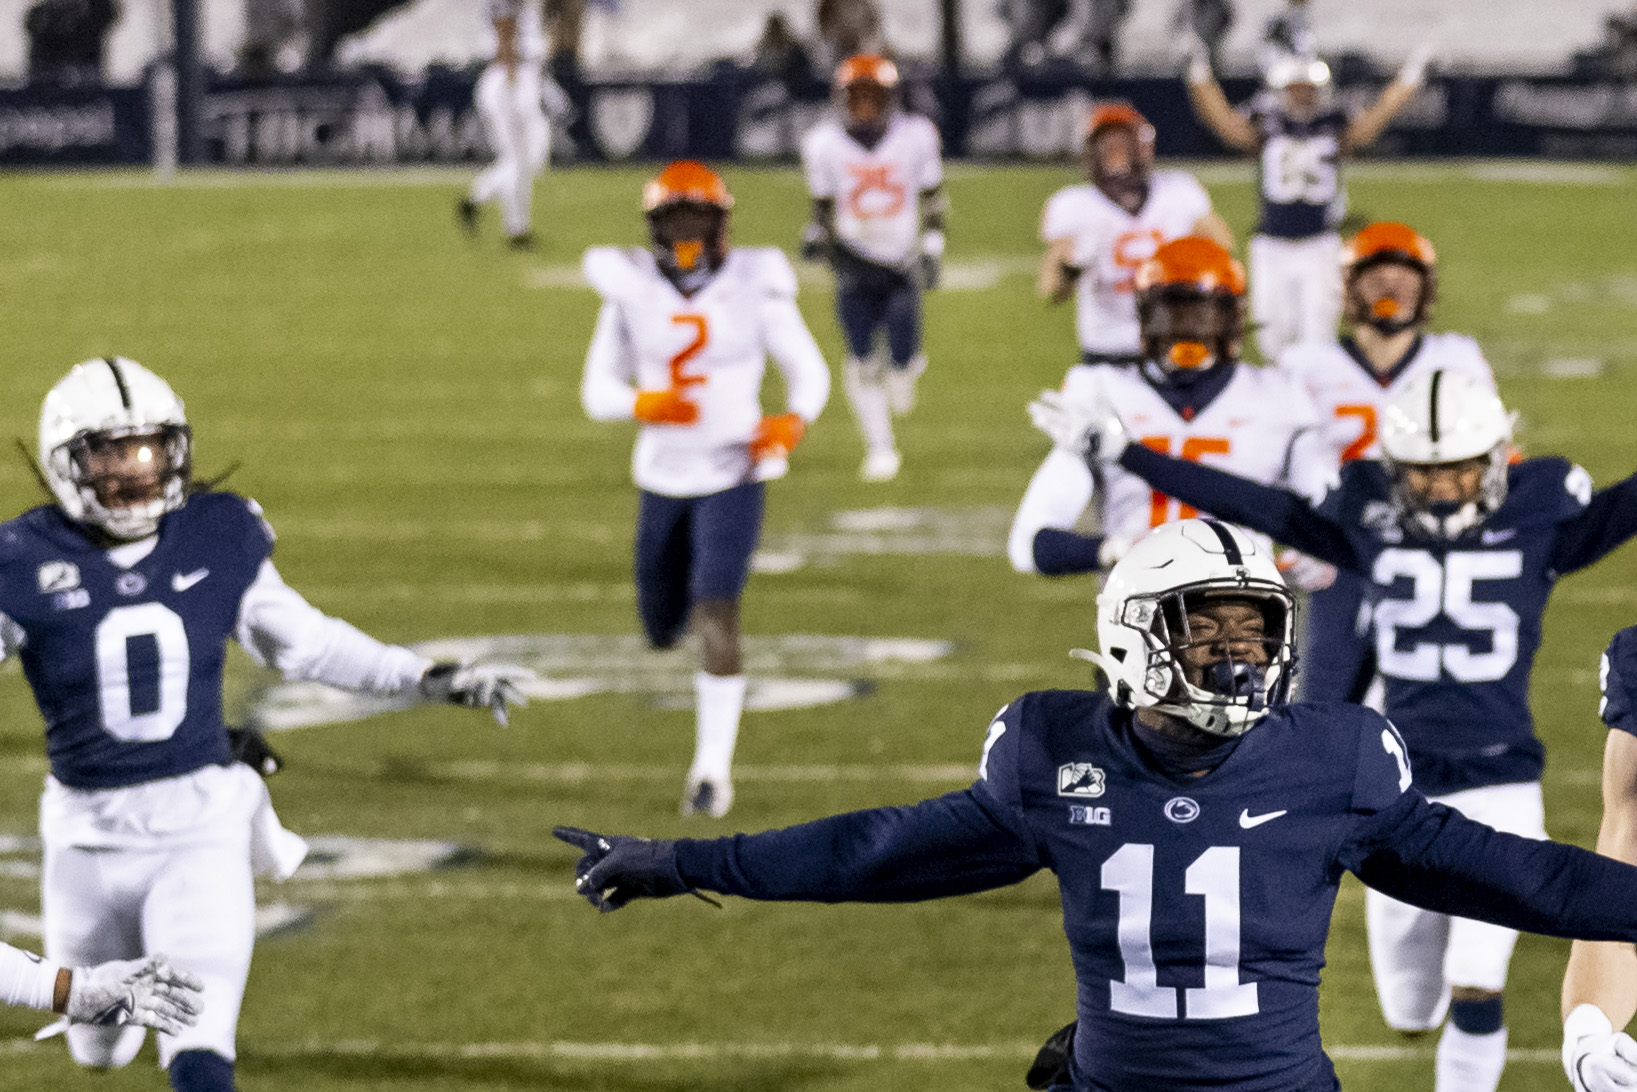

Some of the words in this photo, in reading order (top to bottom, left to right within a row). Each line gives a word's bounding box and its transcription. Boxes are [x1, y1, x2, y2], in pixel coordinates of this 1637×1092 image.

[670, 312, 708, 390] 2
[95, 601, 190, 742] 0
[1372, 547, 1523, 684] 25
[1100, 842, 1260, 1019] 11
